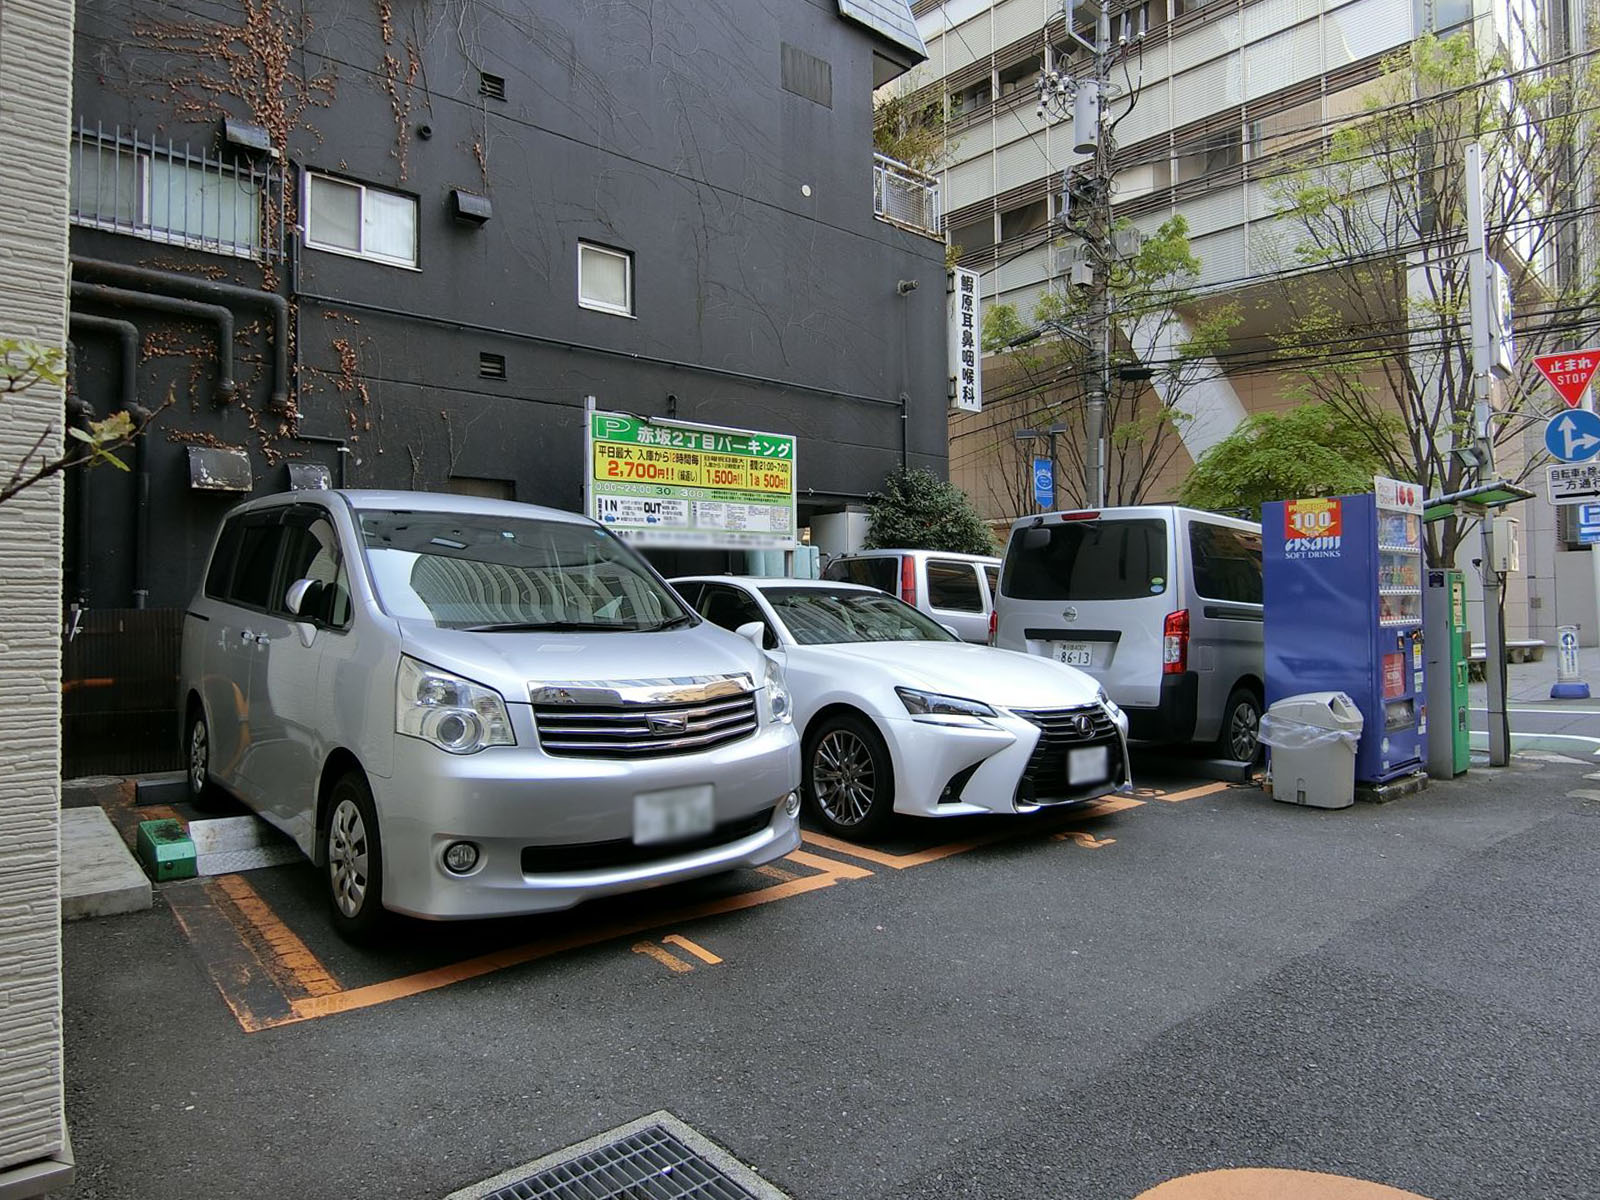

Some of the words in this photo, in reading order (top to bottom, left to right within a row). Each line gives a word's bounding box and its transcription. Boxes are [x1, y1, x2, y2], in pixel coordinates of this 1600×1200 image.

[1549, 357, 1593, 373] 止まれ
[1557, 372, 1588, 385] STOP
[1551, 465, 1600, 480] 自転車を除
[604, 499, 618, 512] IN
[643, 501, 662, 514] OUT
[1291, 510, 1332, 530] 100
[1285, 551, 1307, 560] SOFT
[1308, 549, 1341, 559] DRINKS
